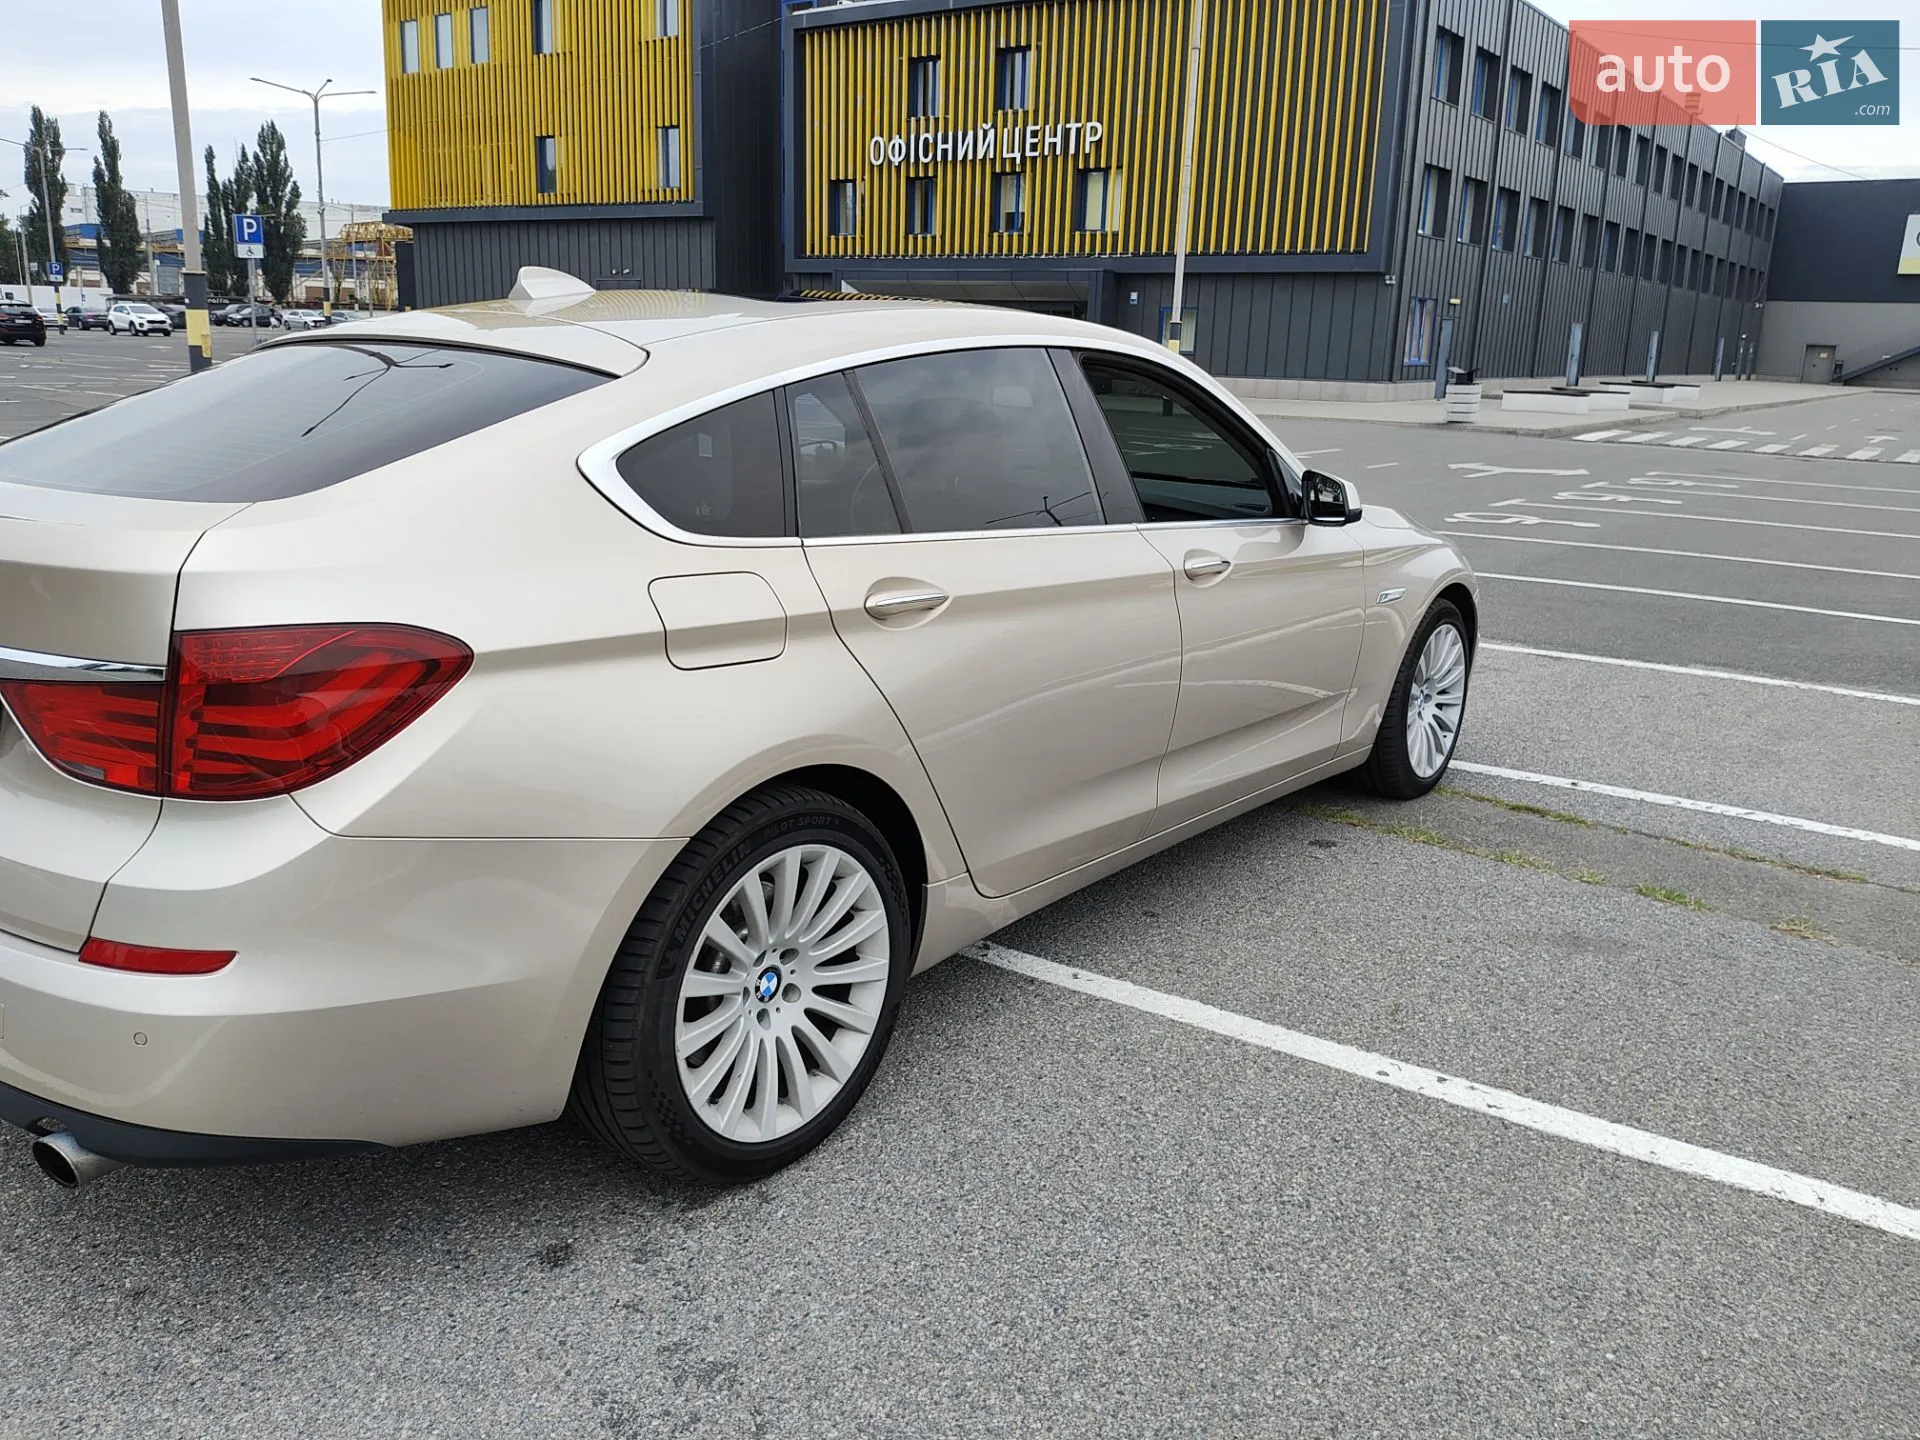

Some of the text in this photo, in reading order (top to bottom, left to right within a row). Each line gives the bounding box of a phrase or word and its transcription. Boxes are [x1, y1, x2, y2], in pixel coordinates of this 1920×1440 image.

[869, 121, 1103, 167] ОФІСНИЙ ЦЕНТР
[243, 218, 257, 241] P
[52, 263, 60, 274] P
[674, 840, 752, 944] MICHELIN
